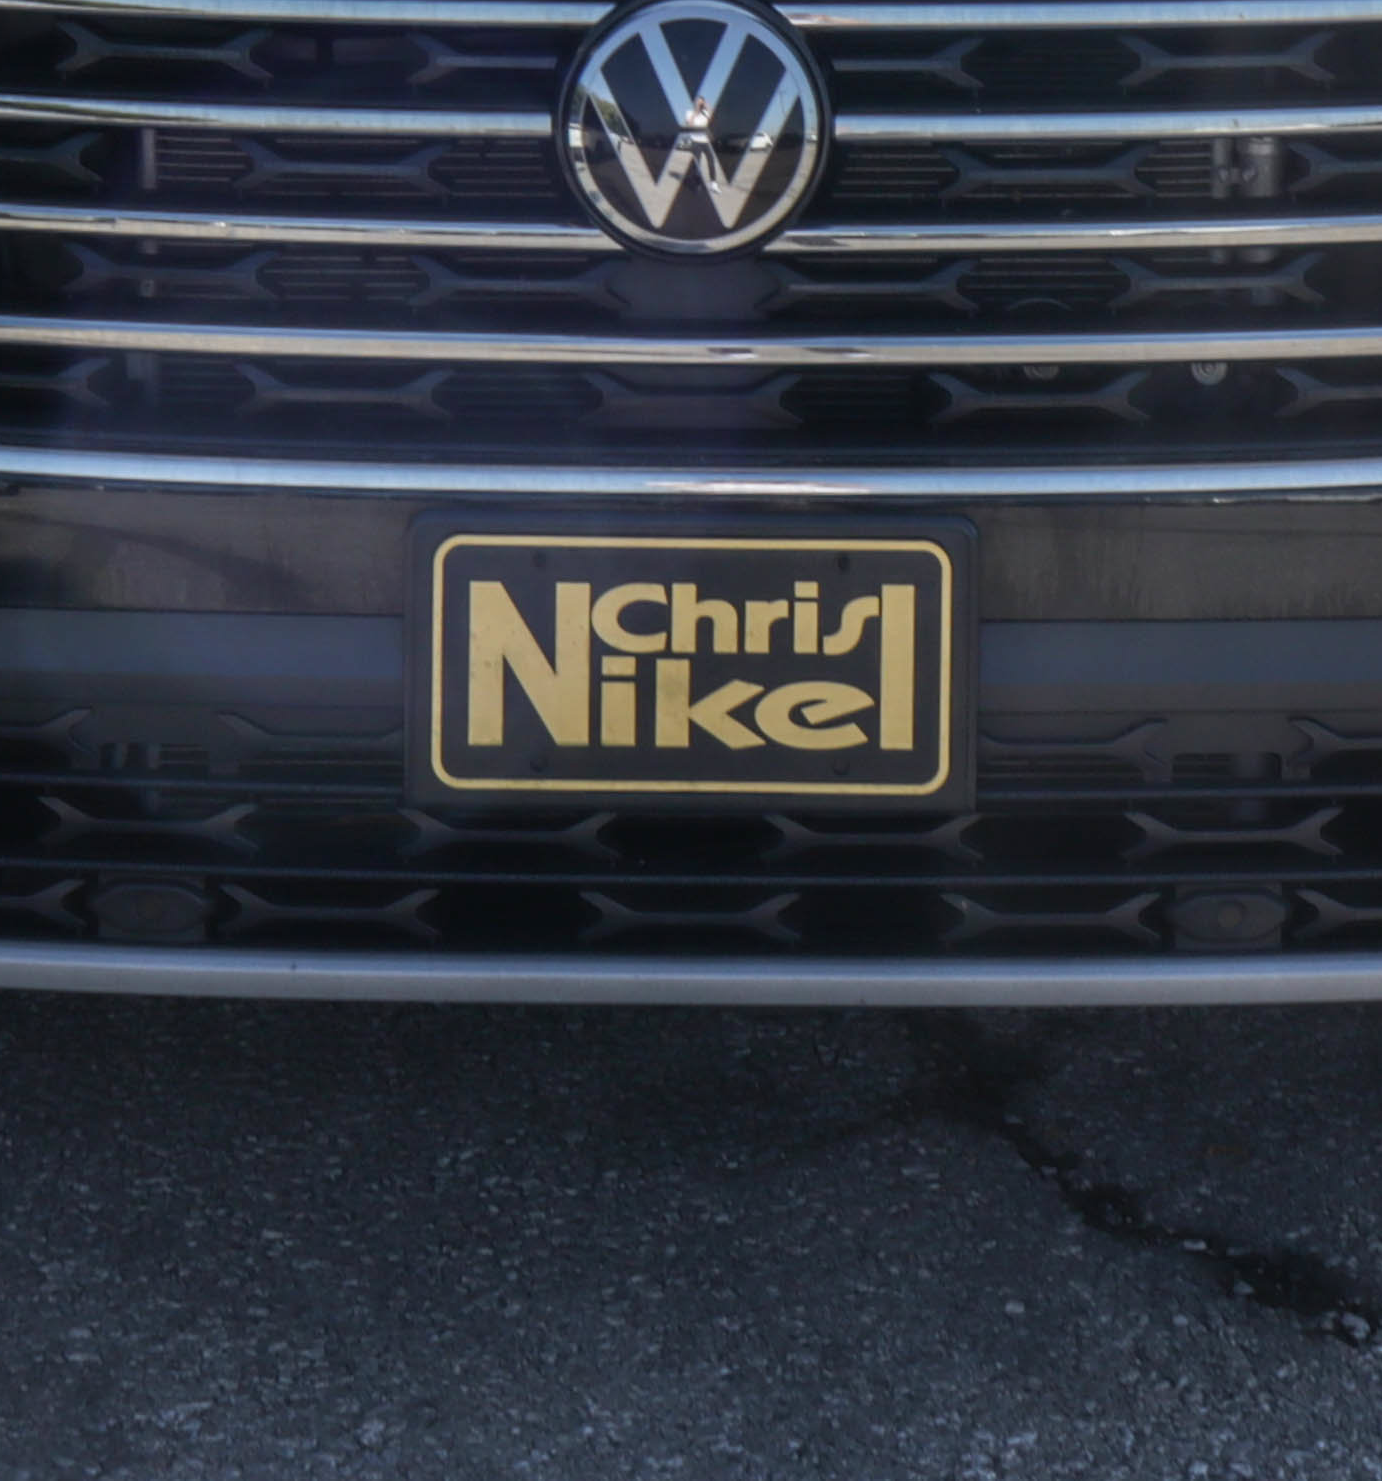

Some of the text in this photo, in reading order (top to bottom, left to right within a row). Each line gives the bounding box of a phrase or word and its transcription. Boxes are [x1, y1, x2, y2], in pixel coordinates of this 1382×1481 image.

[581, 15, 807, 230] VW
[468, 580, 915, 751] Nikel
[591, 580, 880, 656] Chris
